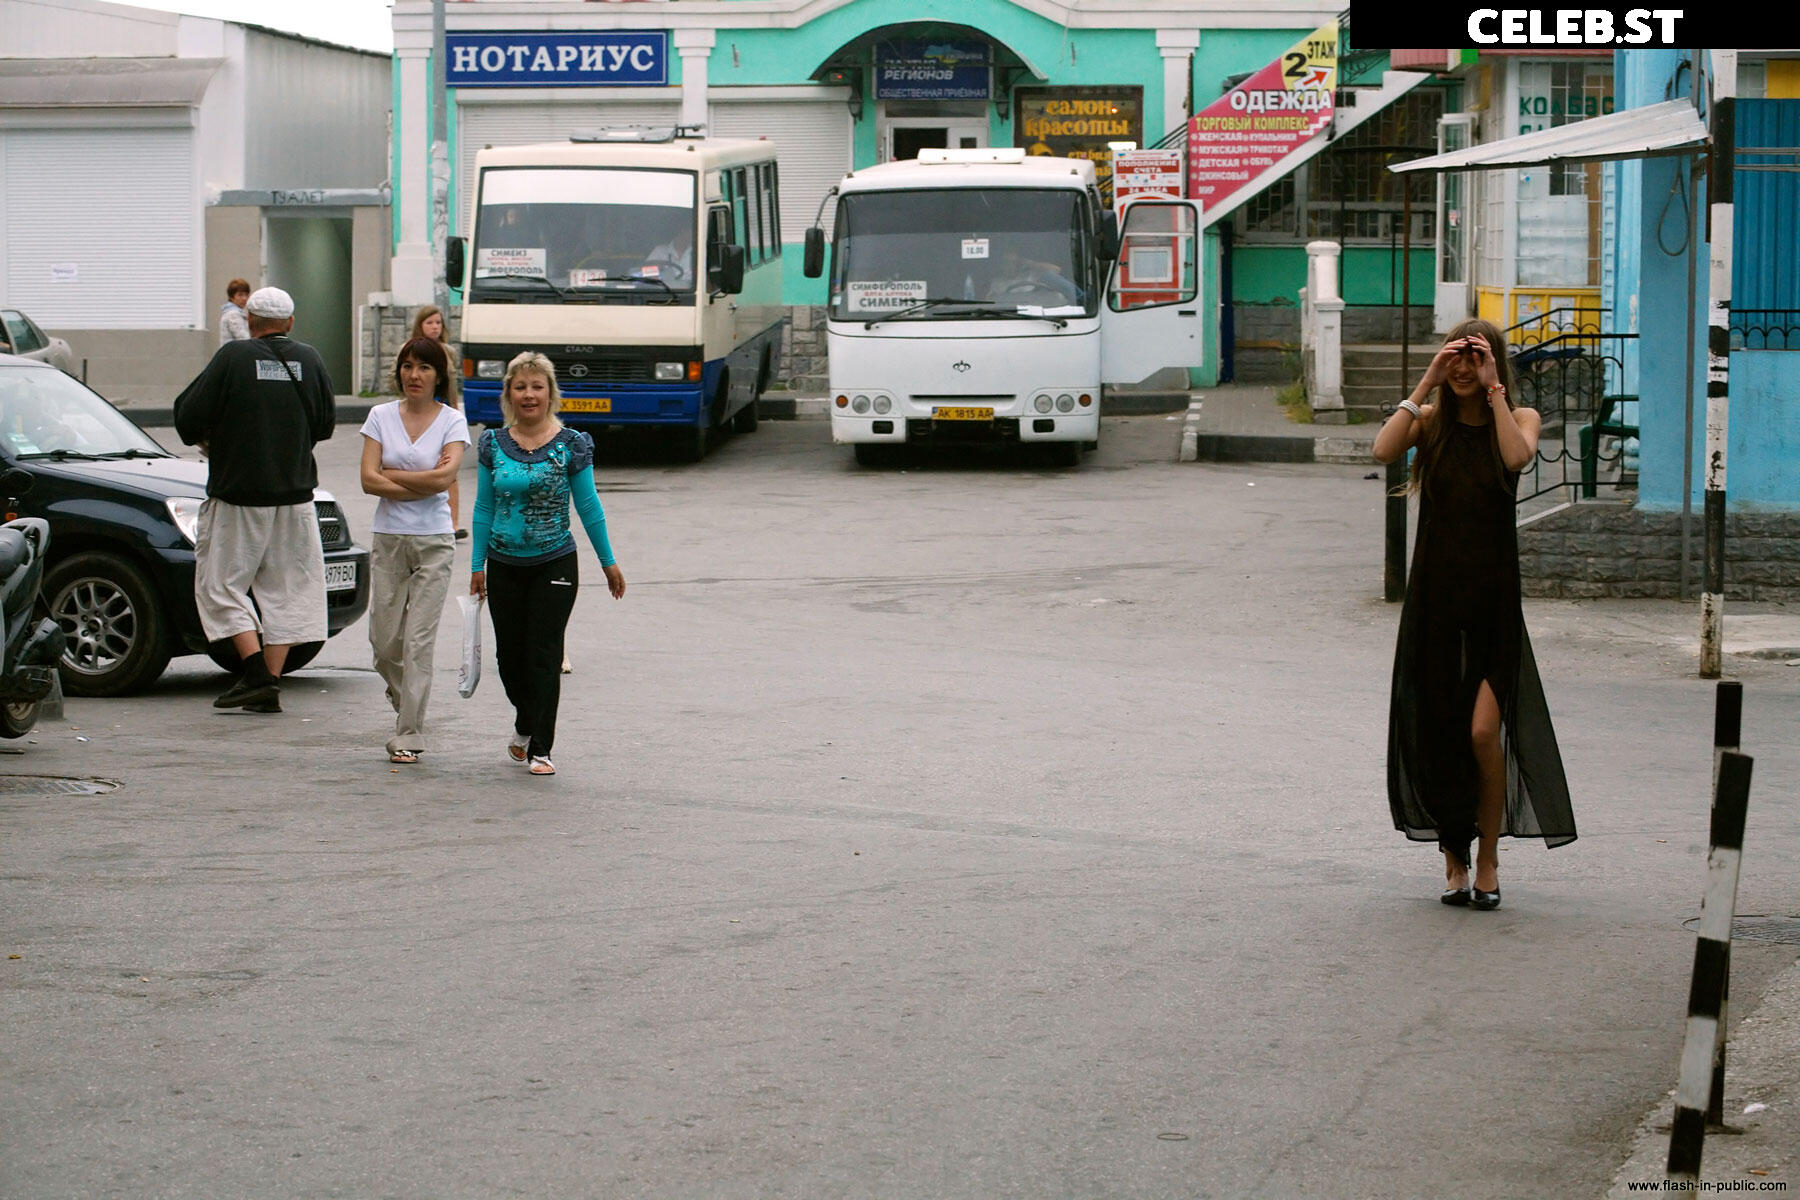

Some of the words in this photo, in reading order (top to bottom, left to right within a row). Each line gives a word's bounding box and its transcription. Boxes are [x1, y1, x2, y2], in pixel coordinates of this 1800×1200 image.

[1307, 41, 1336, 59] ЭТАЖ
[452, 45, 654, 72] НОТАРИУС
[1285, 53, 1307, 77] 2
[884, 70, 954, 80] РЕГИОНОВ
[1046, 100, 1113, 115] салон
[1230, 90, 1332, 113] ОДЕЖДА
[1196, 116, 1251, 130] ТОРГОВЫЙ
[1254, 117, 1309, 130] КОМПЛЕКС
[1199, 132, 1242, 141] ЖЕНСКАЯ
[1199, 145, 1242, 154] МУЖСКАЯ
[1199, 159, 1240, 168] ДЕТСКАЯ
[271, 190, 325, 204] ТУАЛЕТ
[851, 282, 922, 291] СИМФЕРОПОЛЬ
